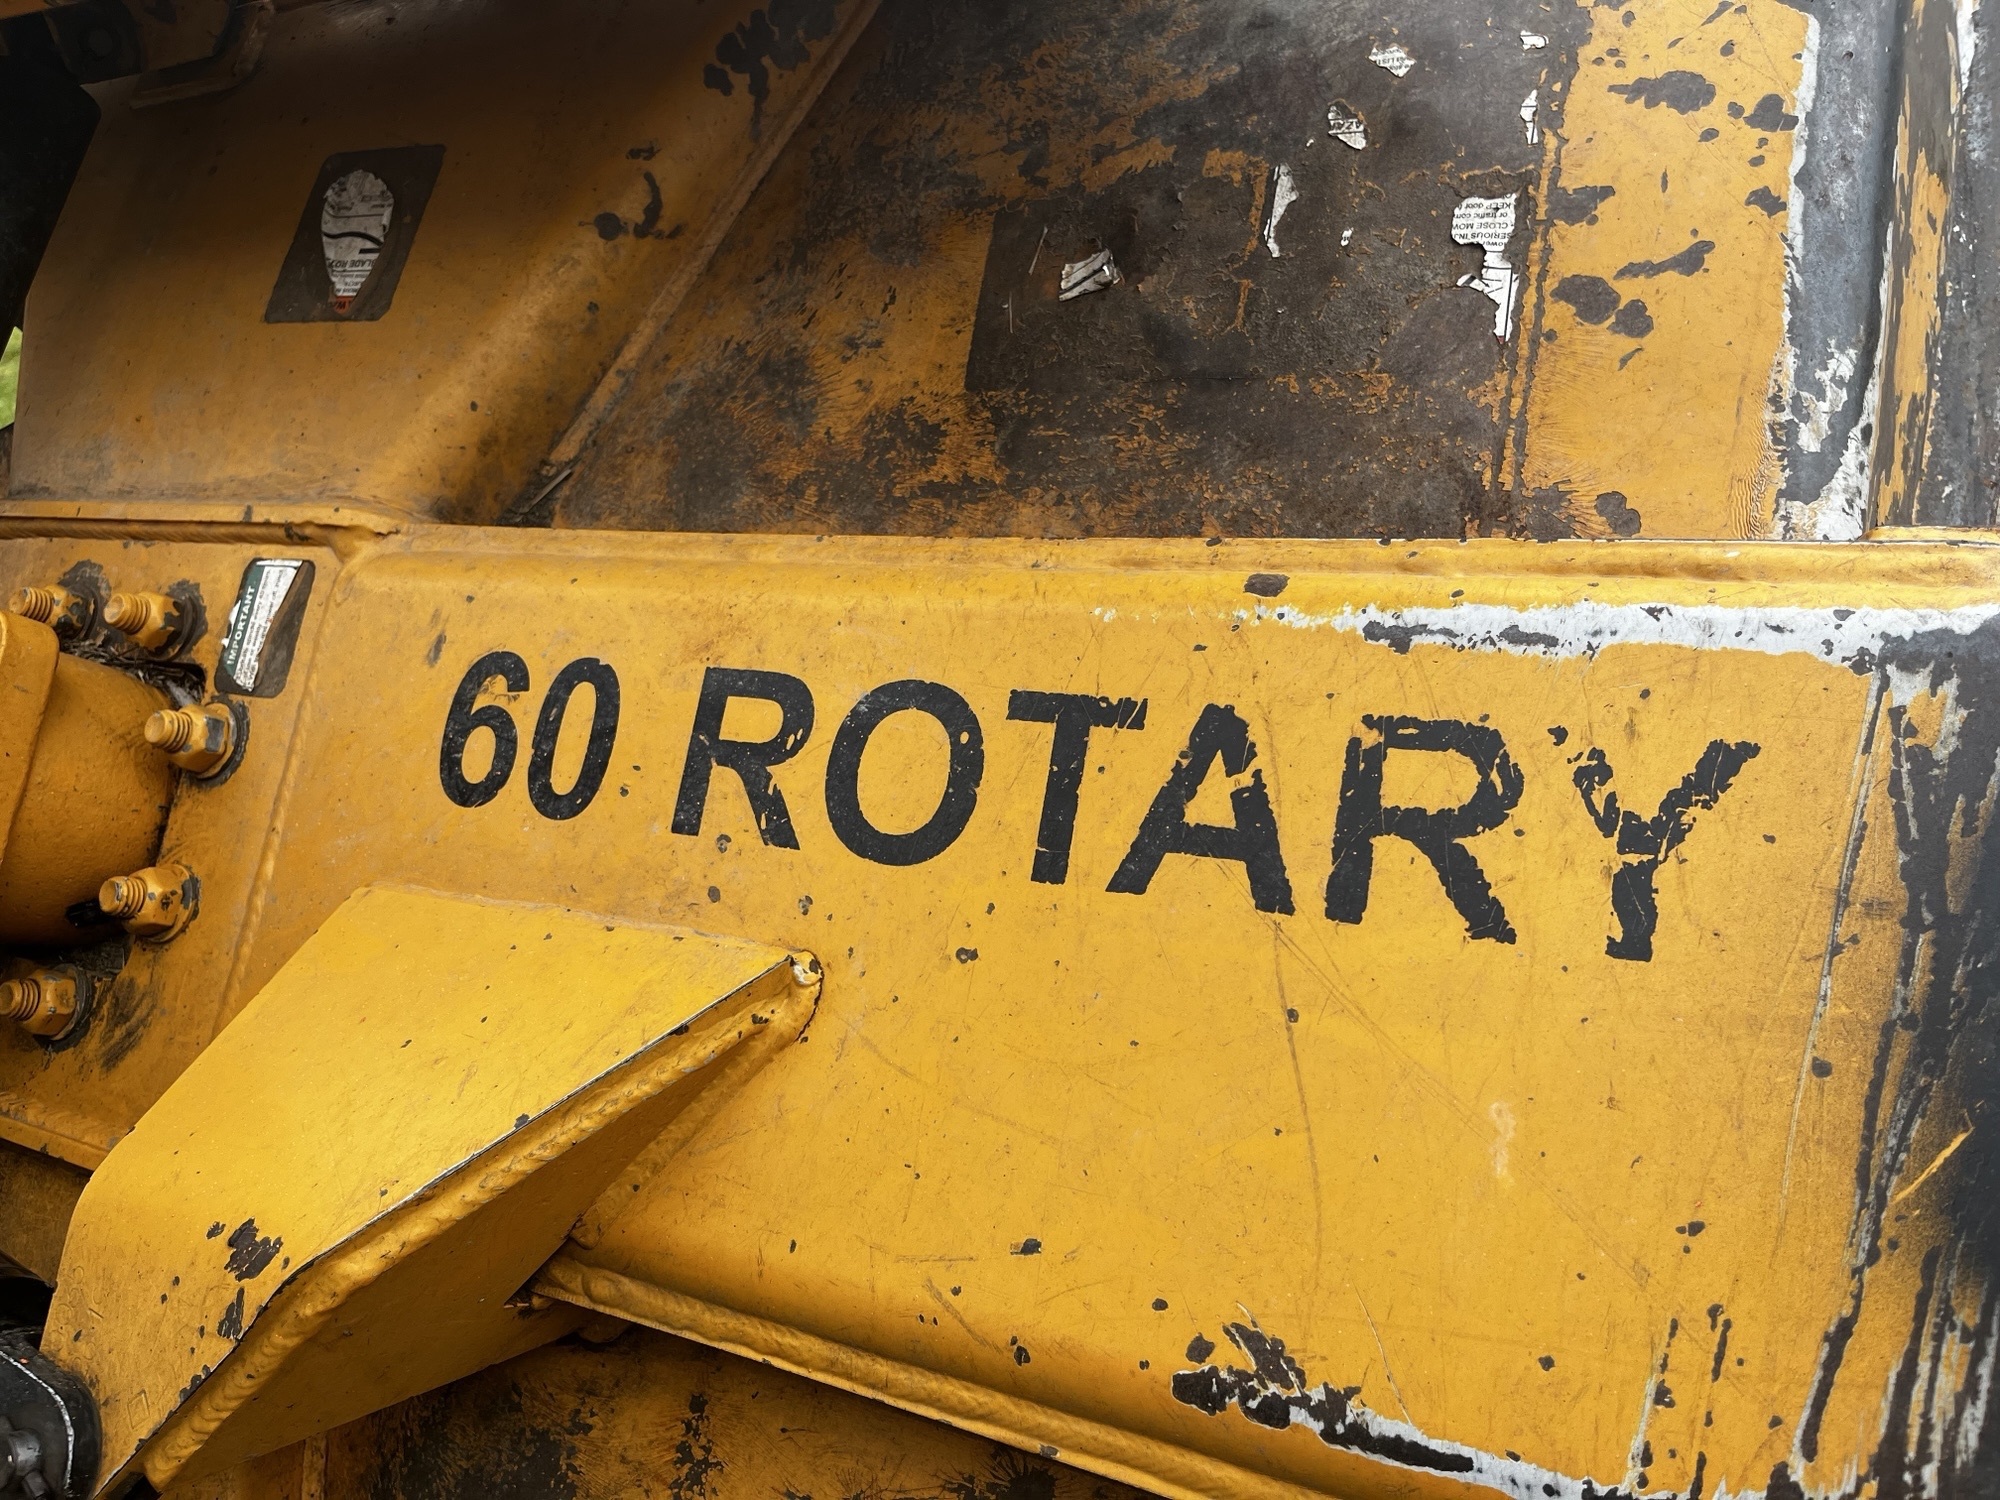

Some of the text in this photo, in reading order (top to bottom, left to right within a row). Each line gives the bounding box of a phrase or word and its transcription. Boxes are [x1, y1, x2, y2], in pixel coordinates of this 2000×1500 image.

[1485, 202, 1511, 210] KEEP
[1471, 232, 1512, 240] SERIOUS
[227, 587, 255, 665] IMPORTANT
[439, 650, 1760, 962] 60 ROTARY
